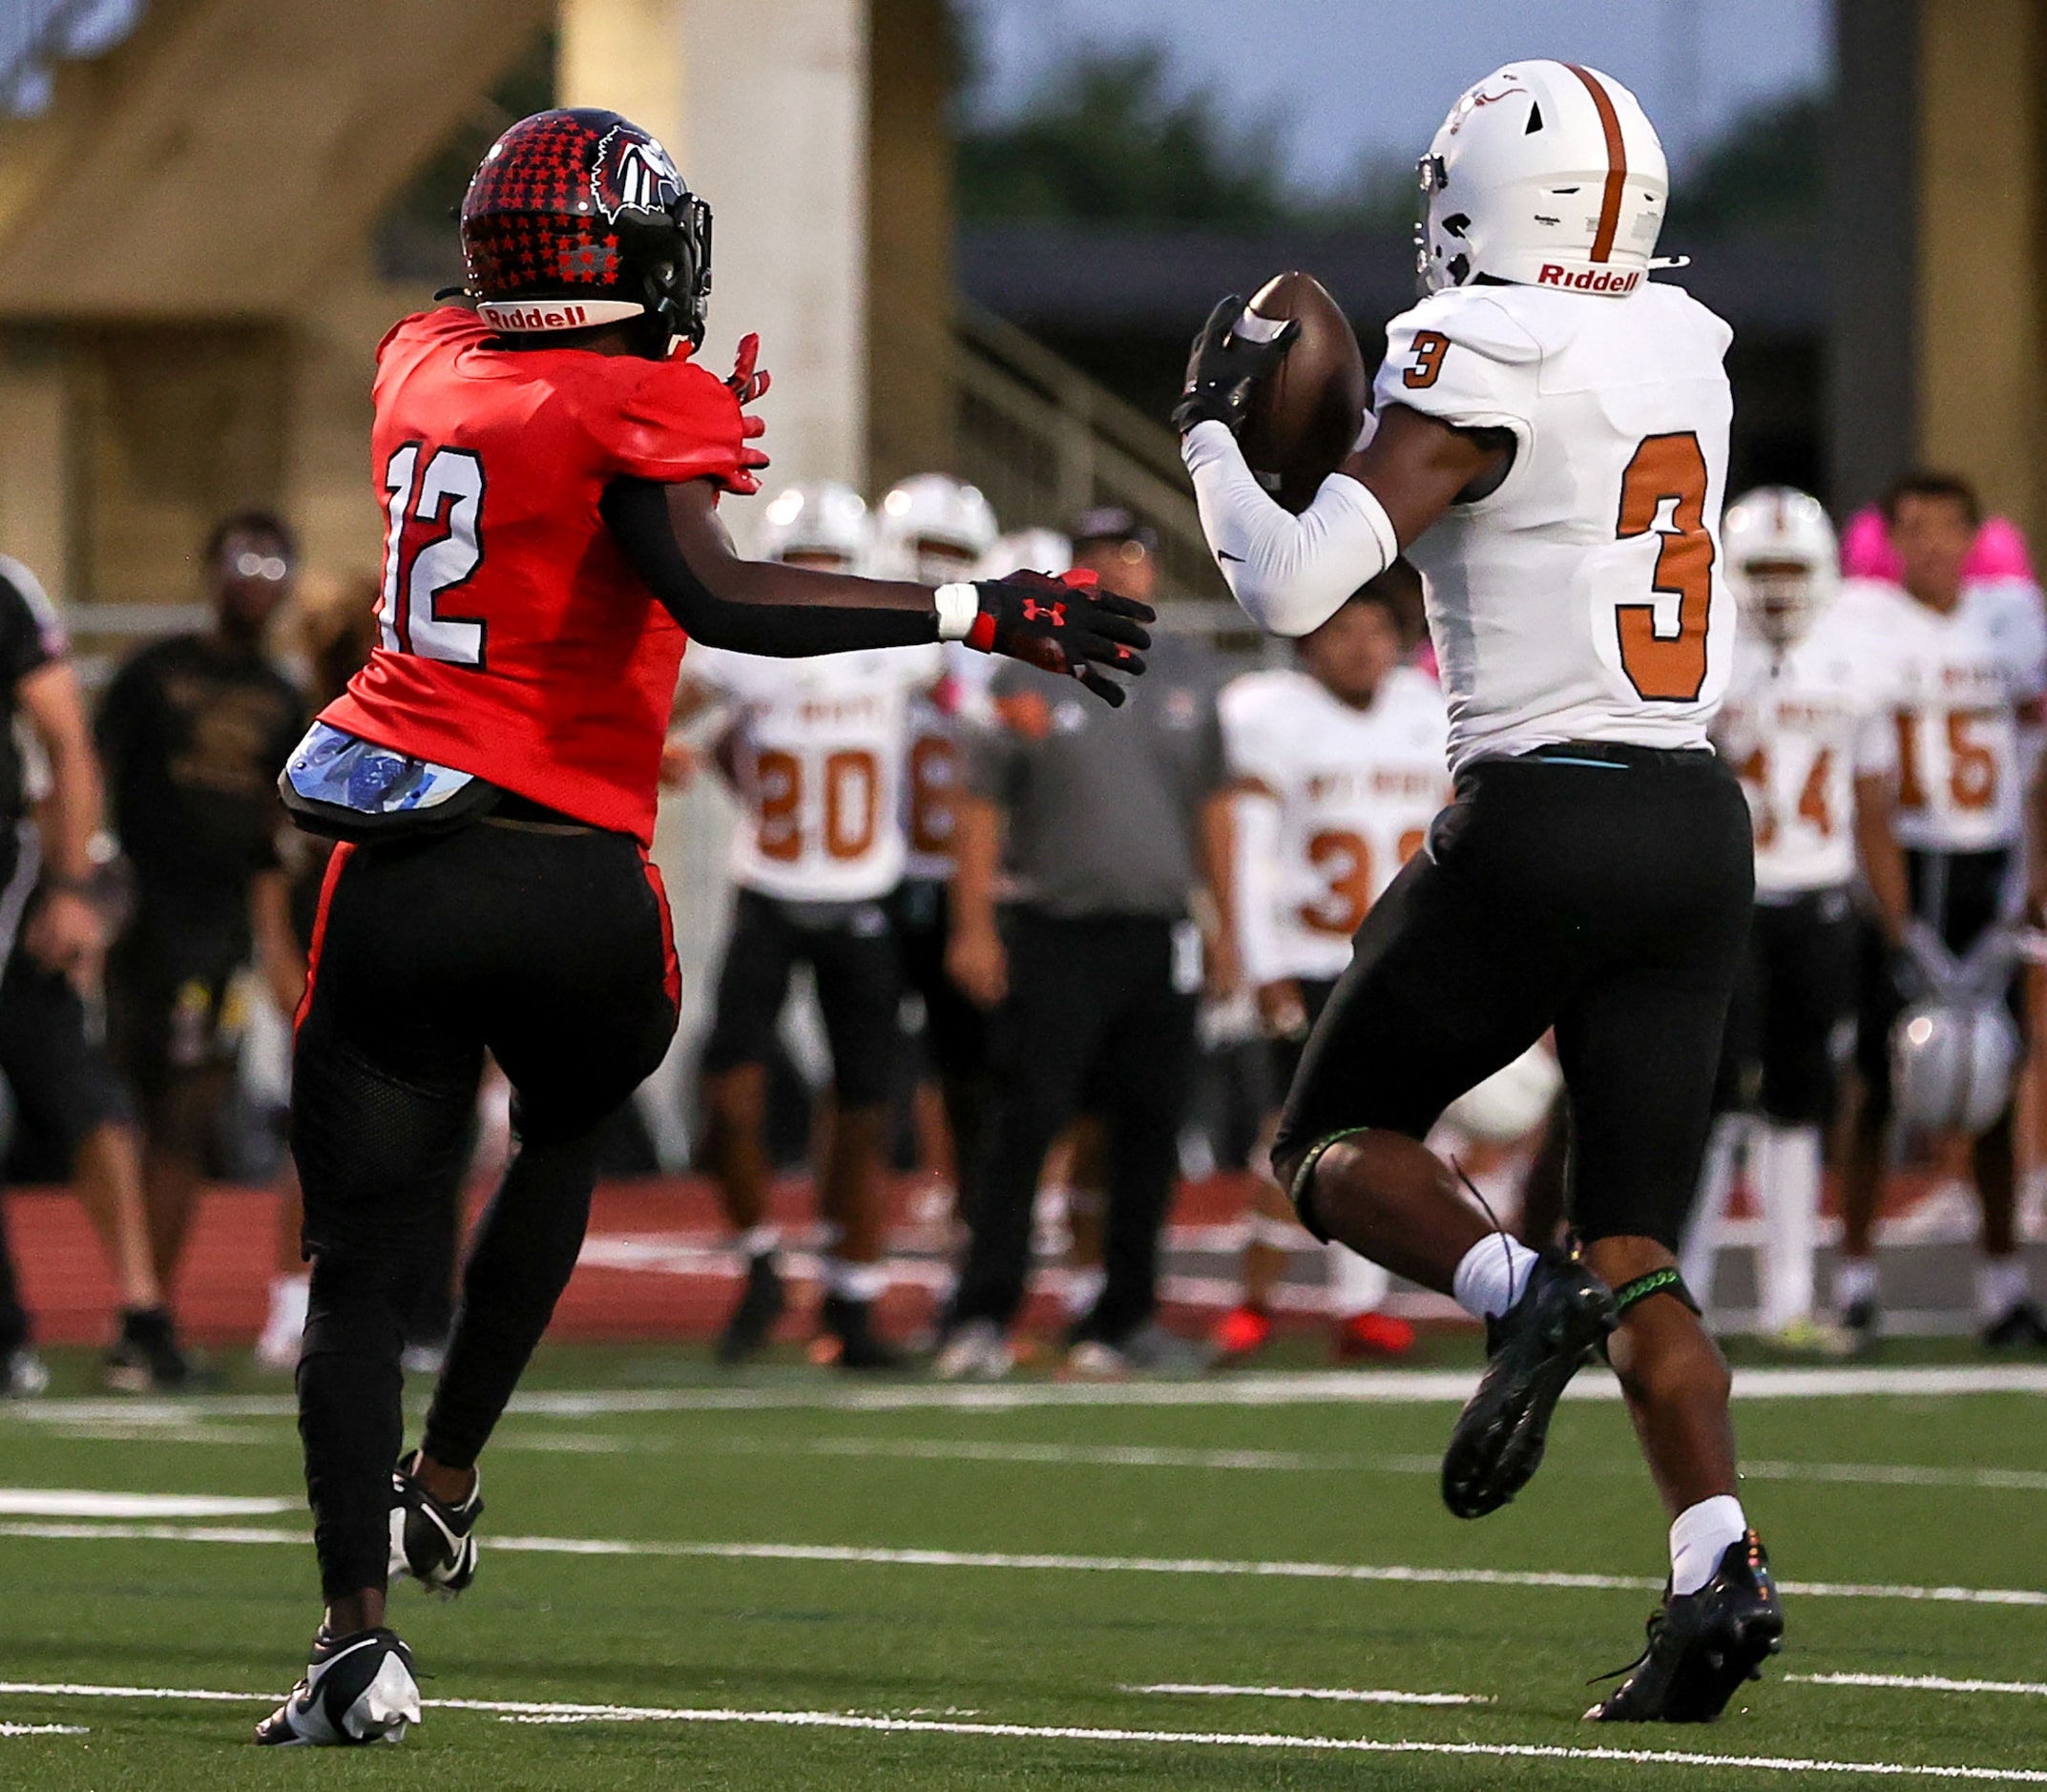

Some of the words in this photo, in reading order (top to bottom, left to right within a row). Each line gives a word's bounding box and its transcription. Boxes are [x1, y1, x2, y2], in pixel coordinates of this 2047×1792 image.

[484, 306, 586, 331] Riddell
[1537, 263, 1640, 293] Riddell
[1402, 329, 1452, 389] 3
[378, 440, 489, 673] 12
[1615, 429, 1716, 703] 3
[1299, 827, 1427, 934] 3
